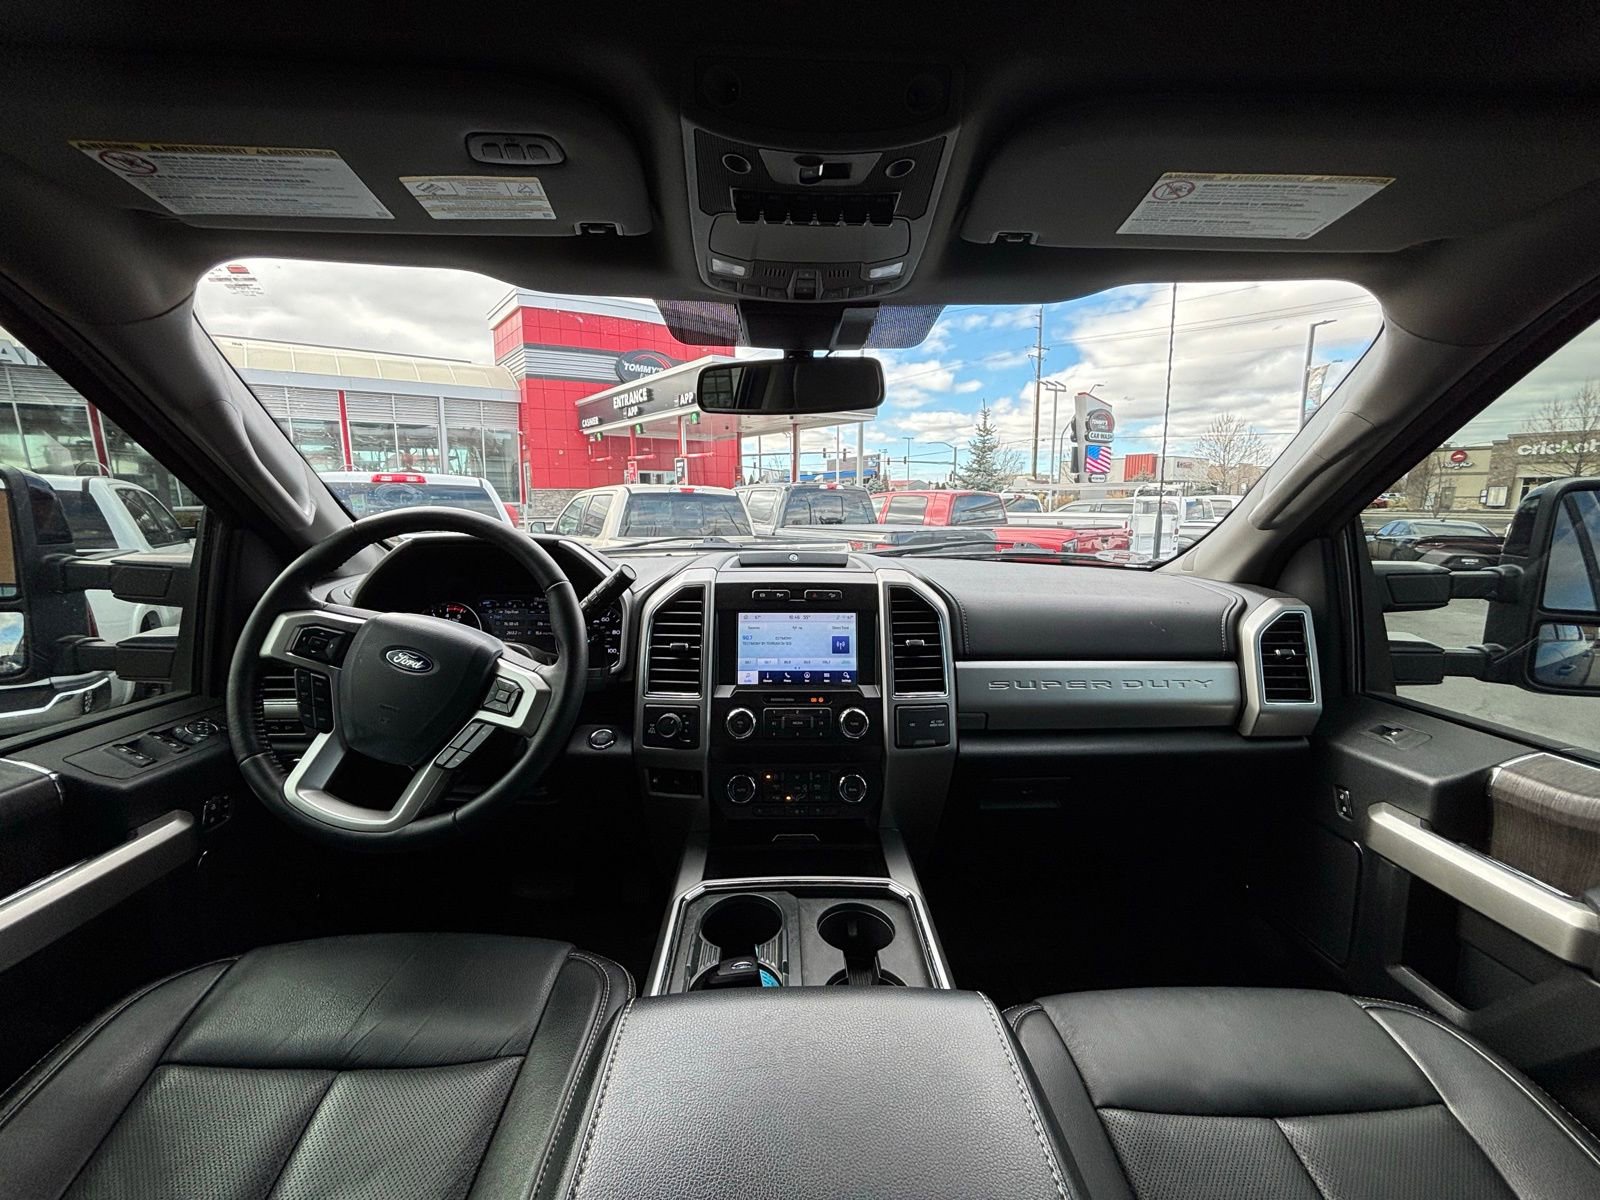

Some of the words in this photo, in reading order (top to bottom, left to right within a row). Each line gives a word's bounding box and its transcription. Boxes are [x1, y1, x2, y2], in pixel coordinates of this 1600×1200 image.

[613, 387, 648, 409] ENTRANCE
[680, 392, 694, 406] APP
[627, 406, 638, 417] APP
[393, 651, 426, 669] Ford
[988, 679, 1112, 690] SUPER
[1121, 679, 1214, 690] DUTY
